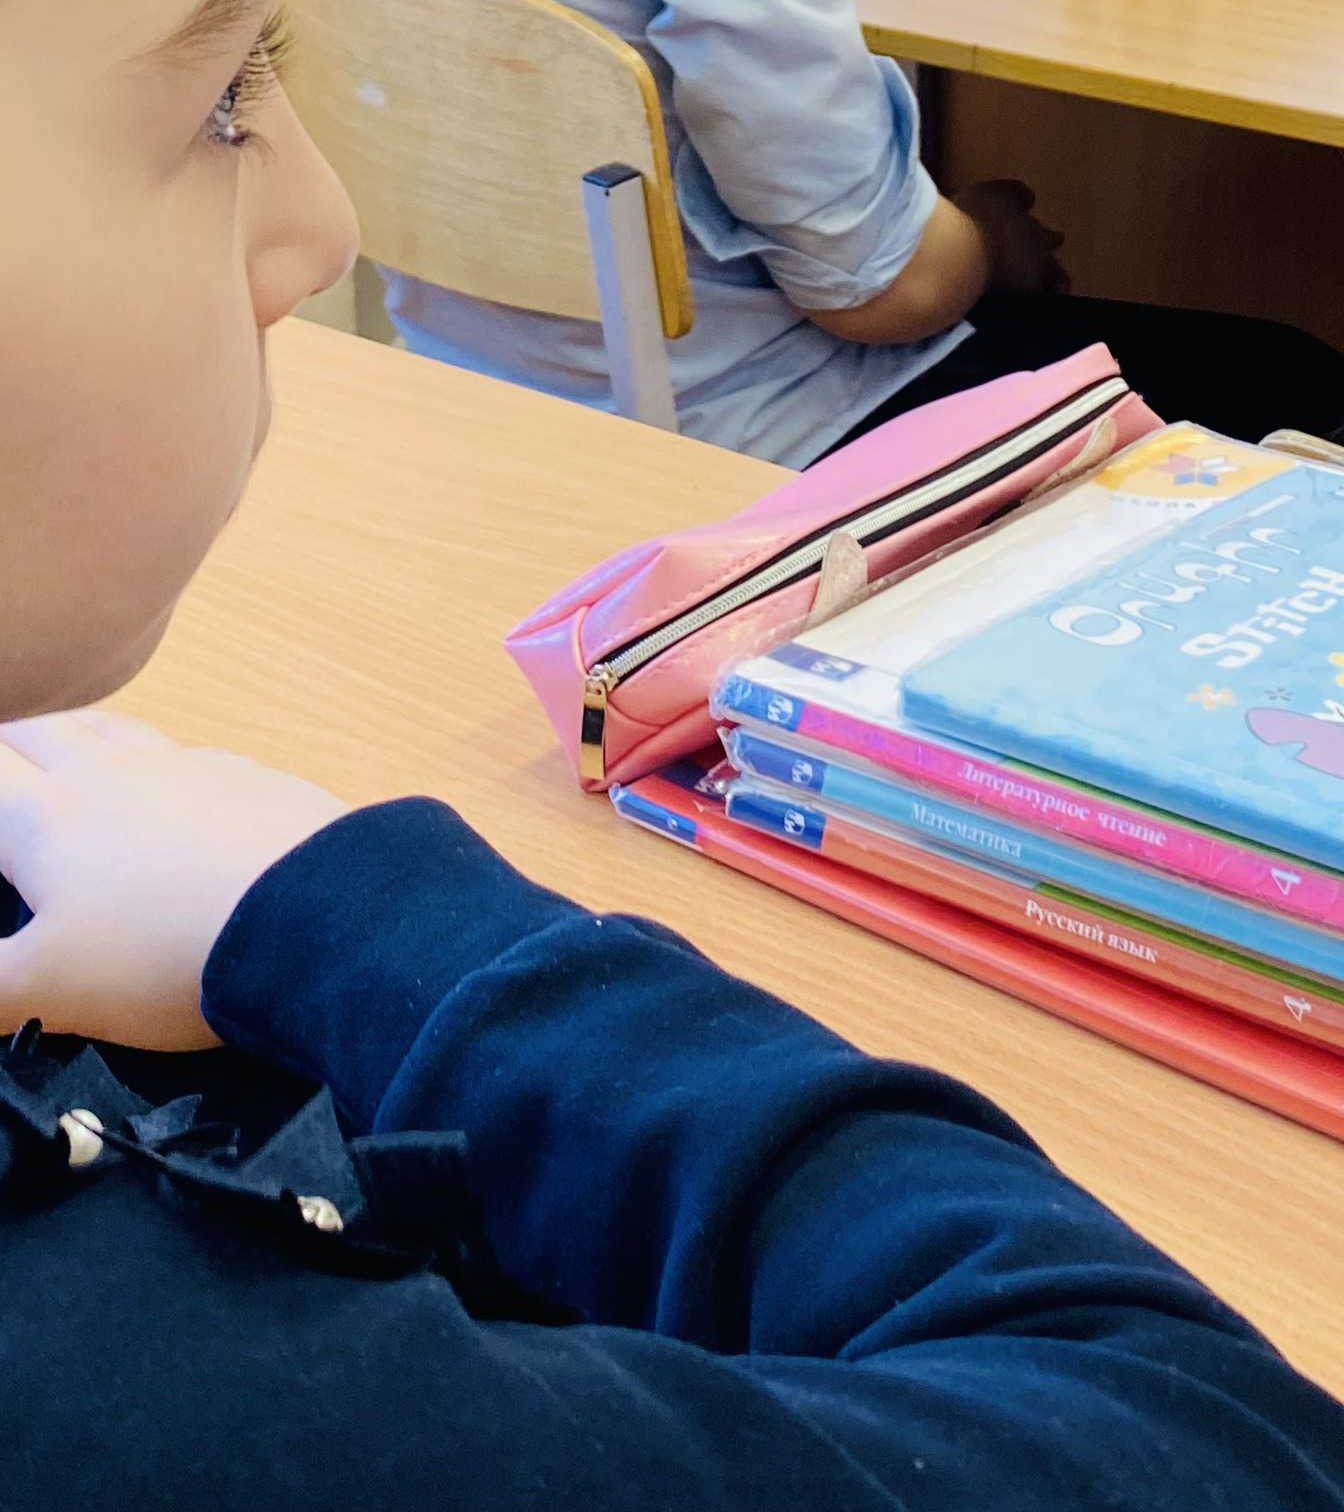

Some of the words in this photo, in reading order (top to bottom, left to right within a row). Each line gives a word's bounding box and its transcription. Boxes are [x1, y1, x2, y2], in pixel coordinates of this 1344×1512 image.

[910, 802, 1023, 859] Математика
[957, 761, 1092, 822] Литературное
[1097, 811, 1168, 848] чтение
[1270, 867, 1302, 896] 4
[1025, 899, 1105, 945] Русский
[1107, 934, 1159, 964] язык
[1283, 994, 1312, 1023] 4
